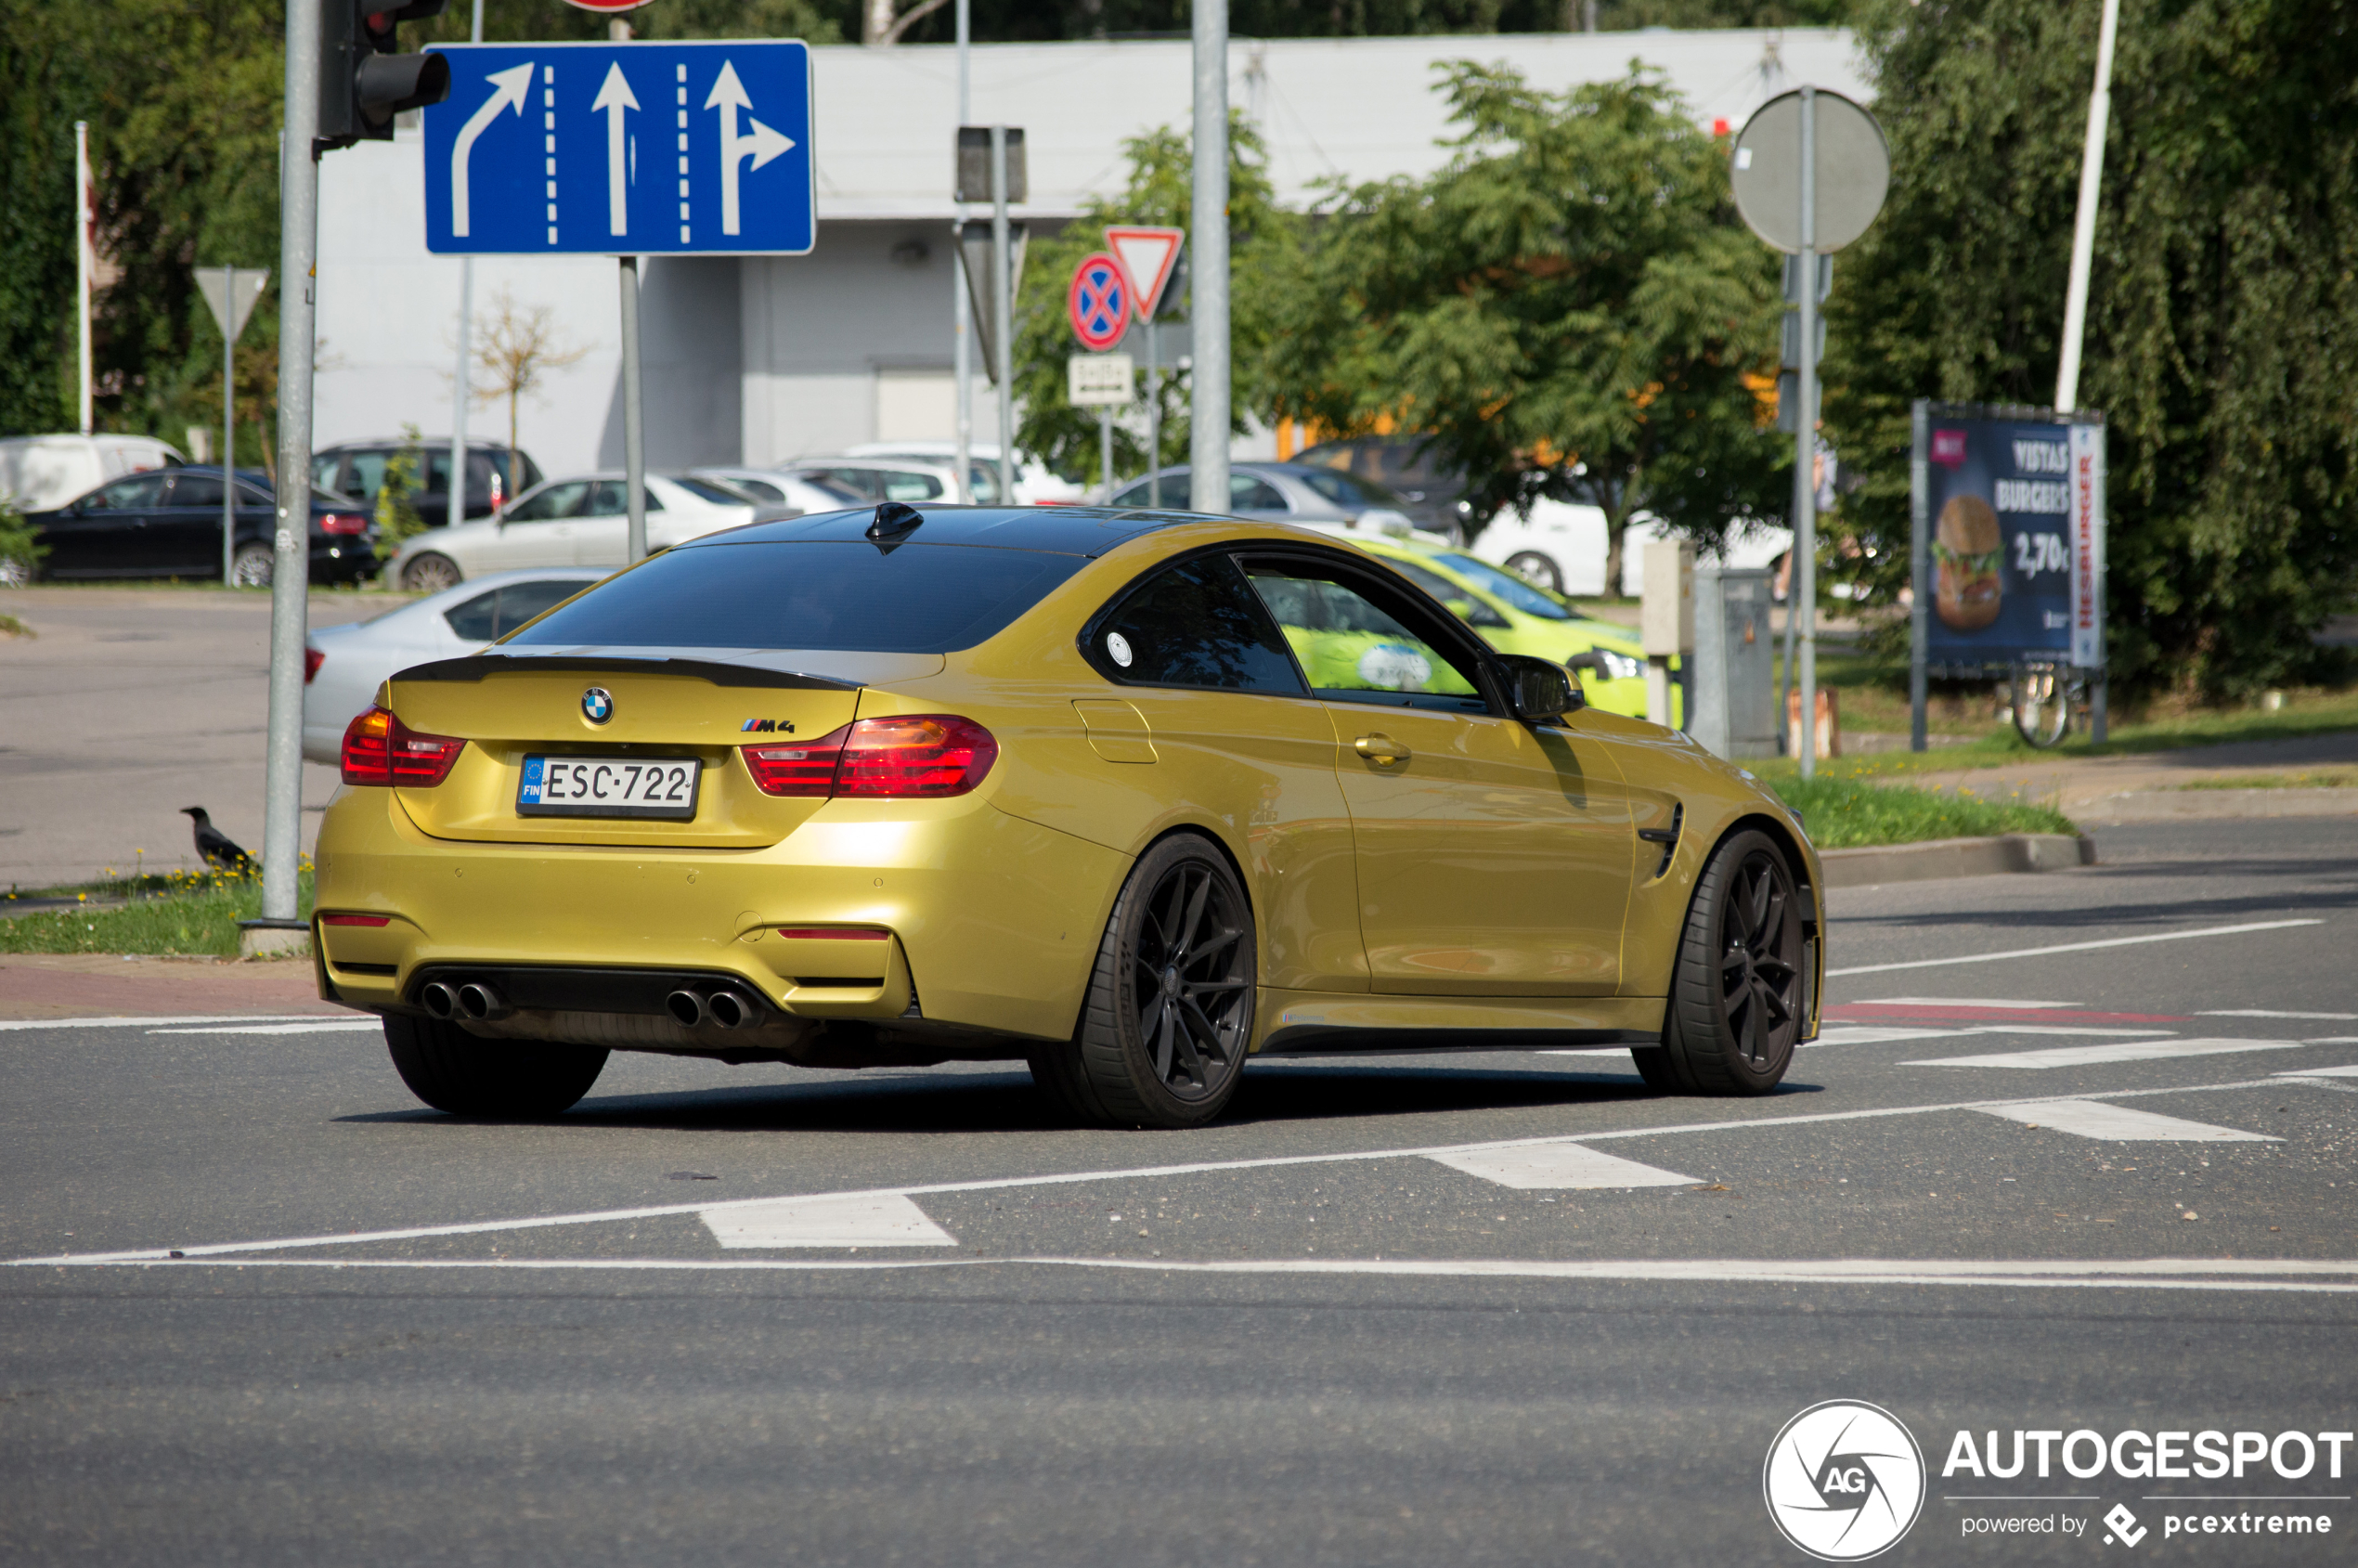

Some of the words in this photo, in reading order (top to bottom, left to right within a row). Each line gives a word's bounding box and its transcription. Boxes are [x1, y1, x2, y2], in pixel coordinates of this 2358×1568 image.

[2013, 439, 2069, 474] VISTAS
[1996, 478, 2070, 514] BURGERS
[2079, 453, 2093, 629] HESBURGER
[583, 688, 610, 701] BMW
[755, 719, 795, 733] M4
[524, 784, 540, 797] FIN
[547, 764, 686, 801] ESC-722
